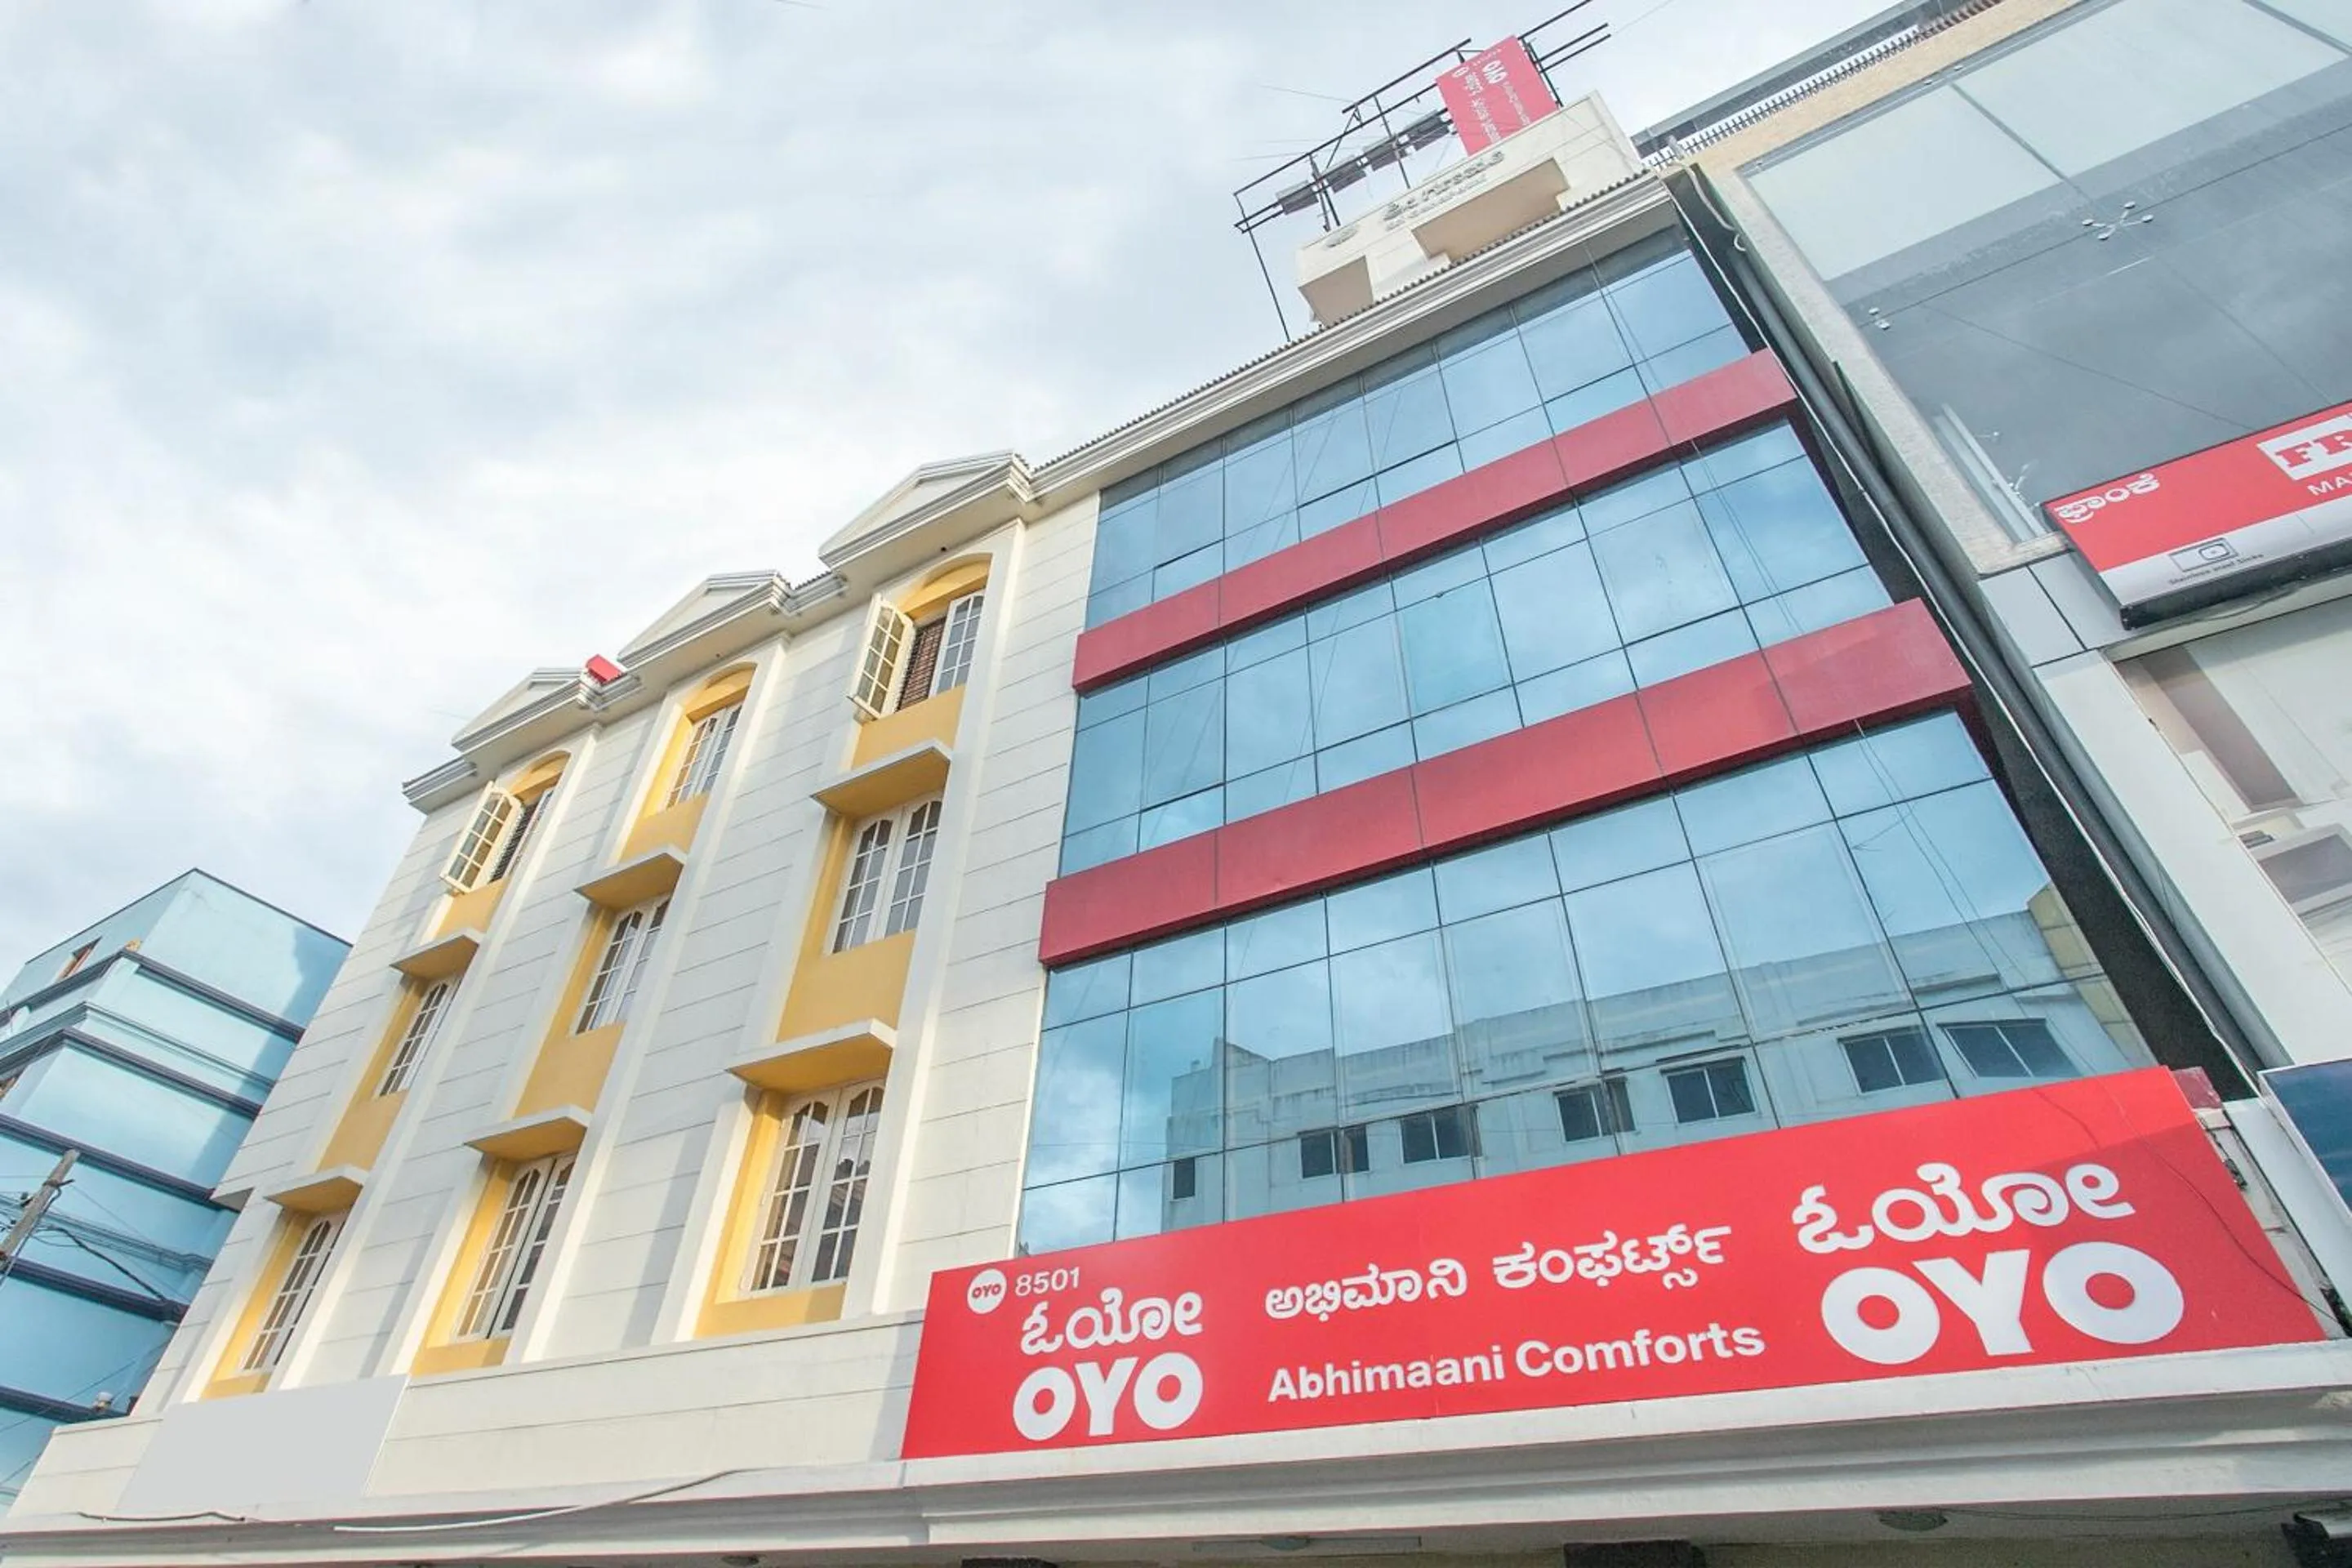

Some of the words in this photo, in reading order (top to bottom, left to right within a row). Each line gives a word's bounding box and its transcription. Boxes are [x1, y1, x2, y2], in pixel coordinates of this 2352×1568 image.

[2307, 473, 2352, 496] MA
[1792, 1163, 2136, 1254] ಓಯೋ
[972, 1283, 1002, 1298] OYO
[1015, 1267, 1080, 1296] 8501
[1265, 1258, 1467, 1321] ಅಭಿಮಾನಿ
[1821, 1241, 2185, 1365] OYO
[1020, 1288, 1203, 1356] ಓಯೋ
[1268, 1345, 1504, 1402] Abhimaani
[1516, 1322, 1766, 1378] Comforts
[1013, 1352, 1203, 1441] OYO
